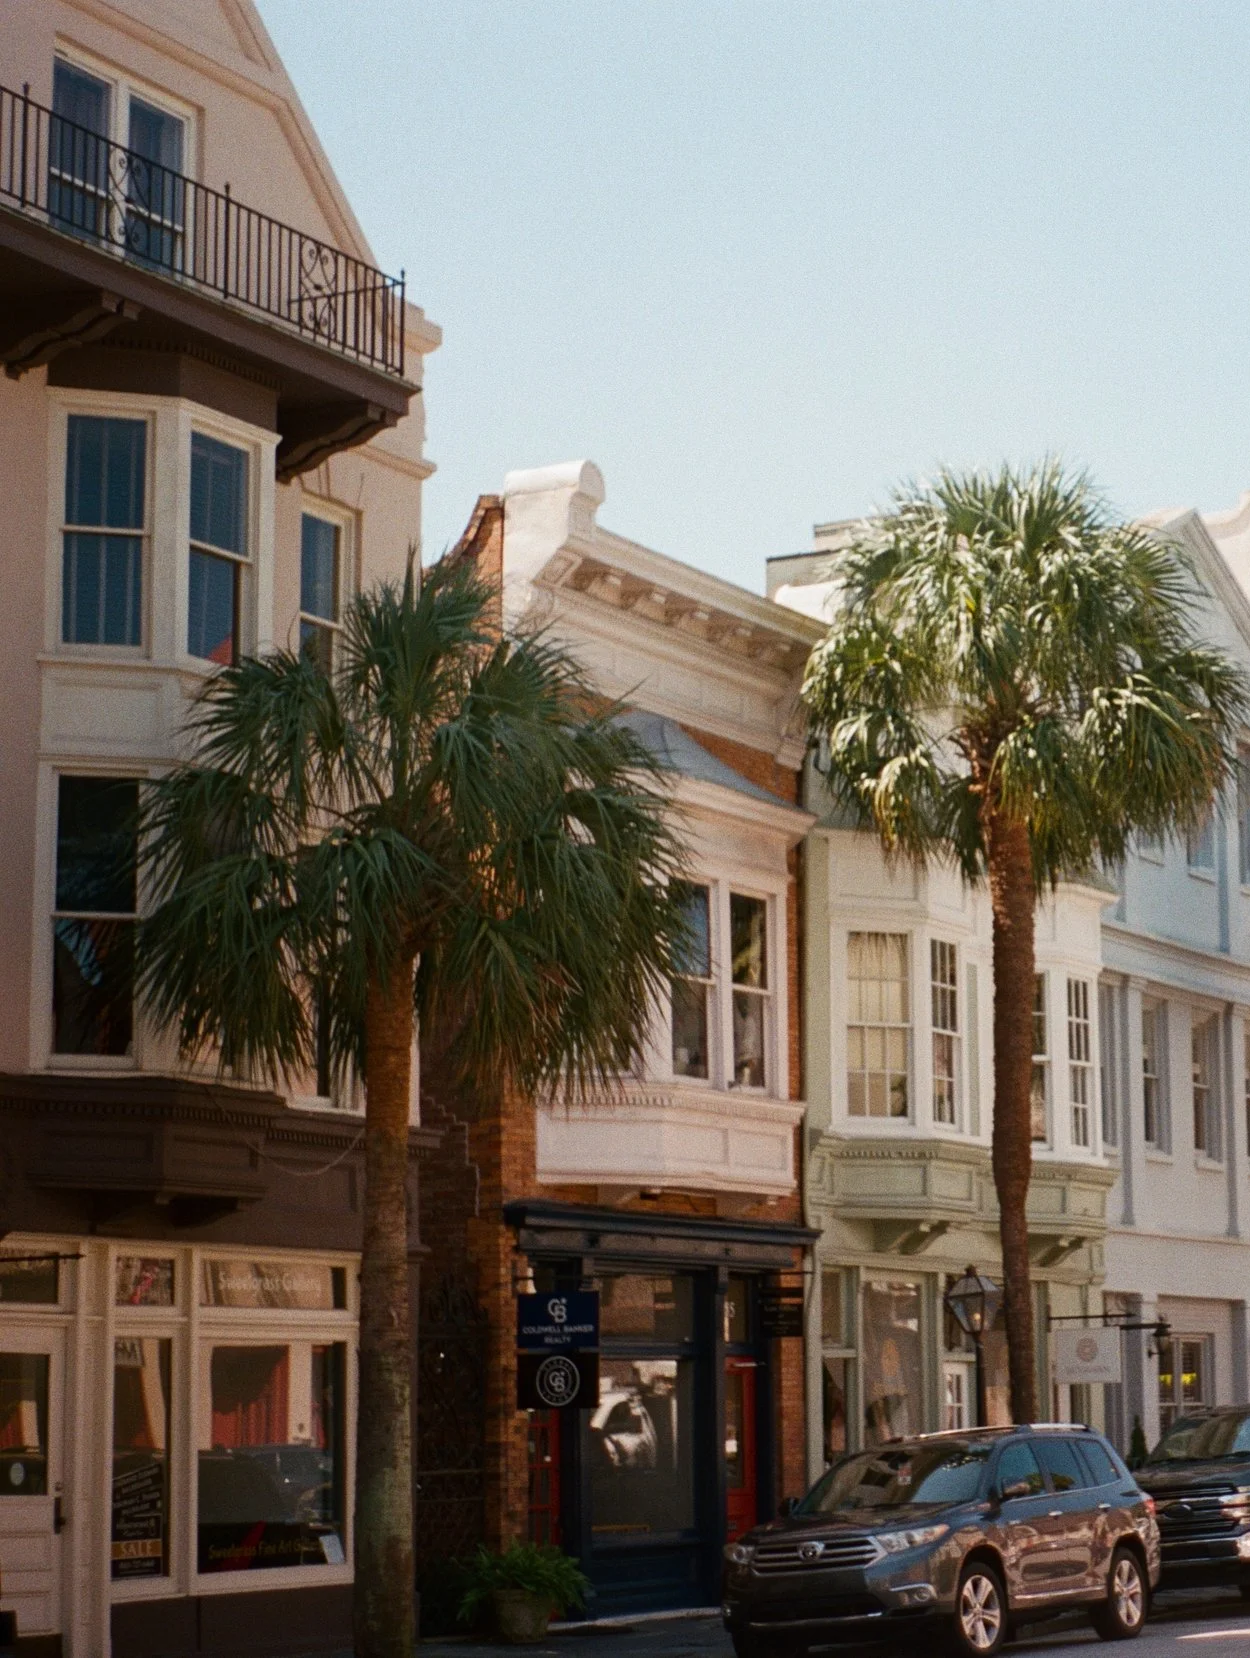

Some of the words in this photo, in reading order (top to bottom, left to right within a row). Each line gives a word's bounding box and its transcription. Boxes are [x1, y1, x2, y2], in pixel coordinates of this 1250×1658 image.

[522, 1325, 561, 1334] COLDWELL
[563, 1324, 594, 1333] BANKER
[543, 1336, 571, 1344] REALTY
[120, 1542, 153, 1558] SALE
